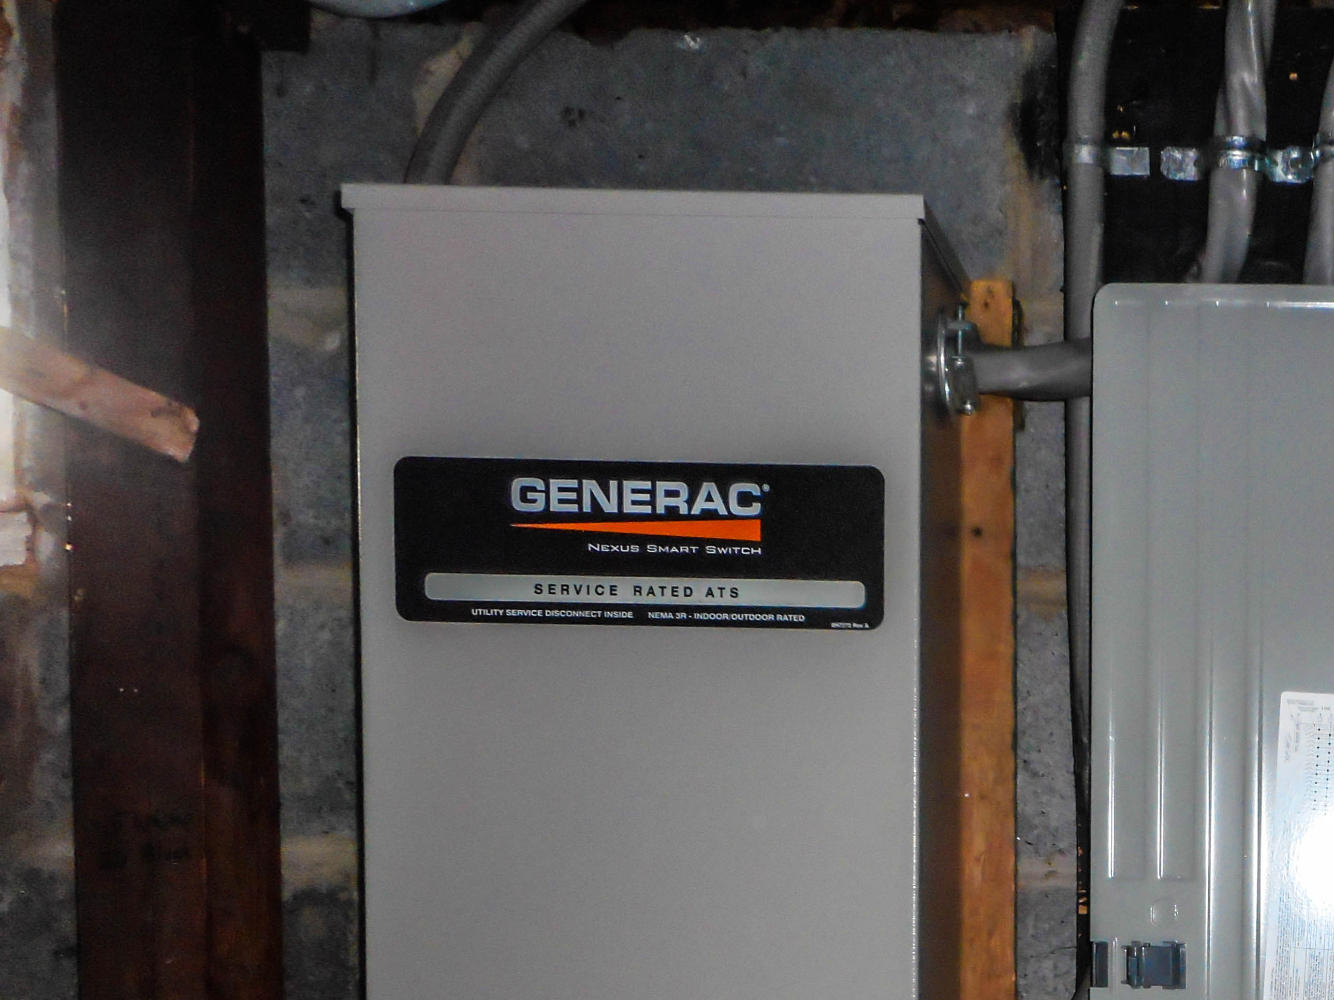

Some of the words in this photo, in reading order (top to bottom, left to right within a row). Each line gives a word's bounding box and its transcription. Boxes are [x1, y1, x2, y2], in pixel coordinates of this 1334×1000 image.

[511, 477, 762, 516] GENERAC
[588, 543, 640, 553] NEXUS
[646, 544, 699, 554] SMART
[705, 545, 762, 555] SWITCH
[534, 583, 619, 596] SERVICE
[633, 584, 694, 597] RATED
[705, 586, 740, 599] ATS
[471, 608, 504, 616] UTILITY
[506, 608, 543, 617] SERVICE
[545, 609, 602, 618] DISCONNECT
[604, 610, 634, 619] INSIDE
[648, 611, 674, 619] NEMA
[776, 614, 805, 622] RATED
